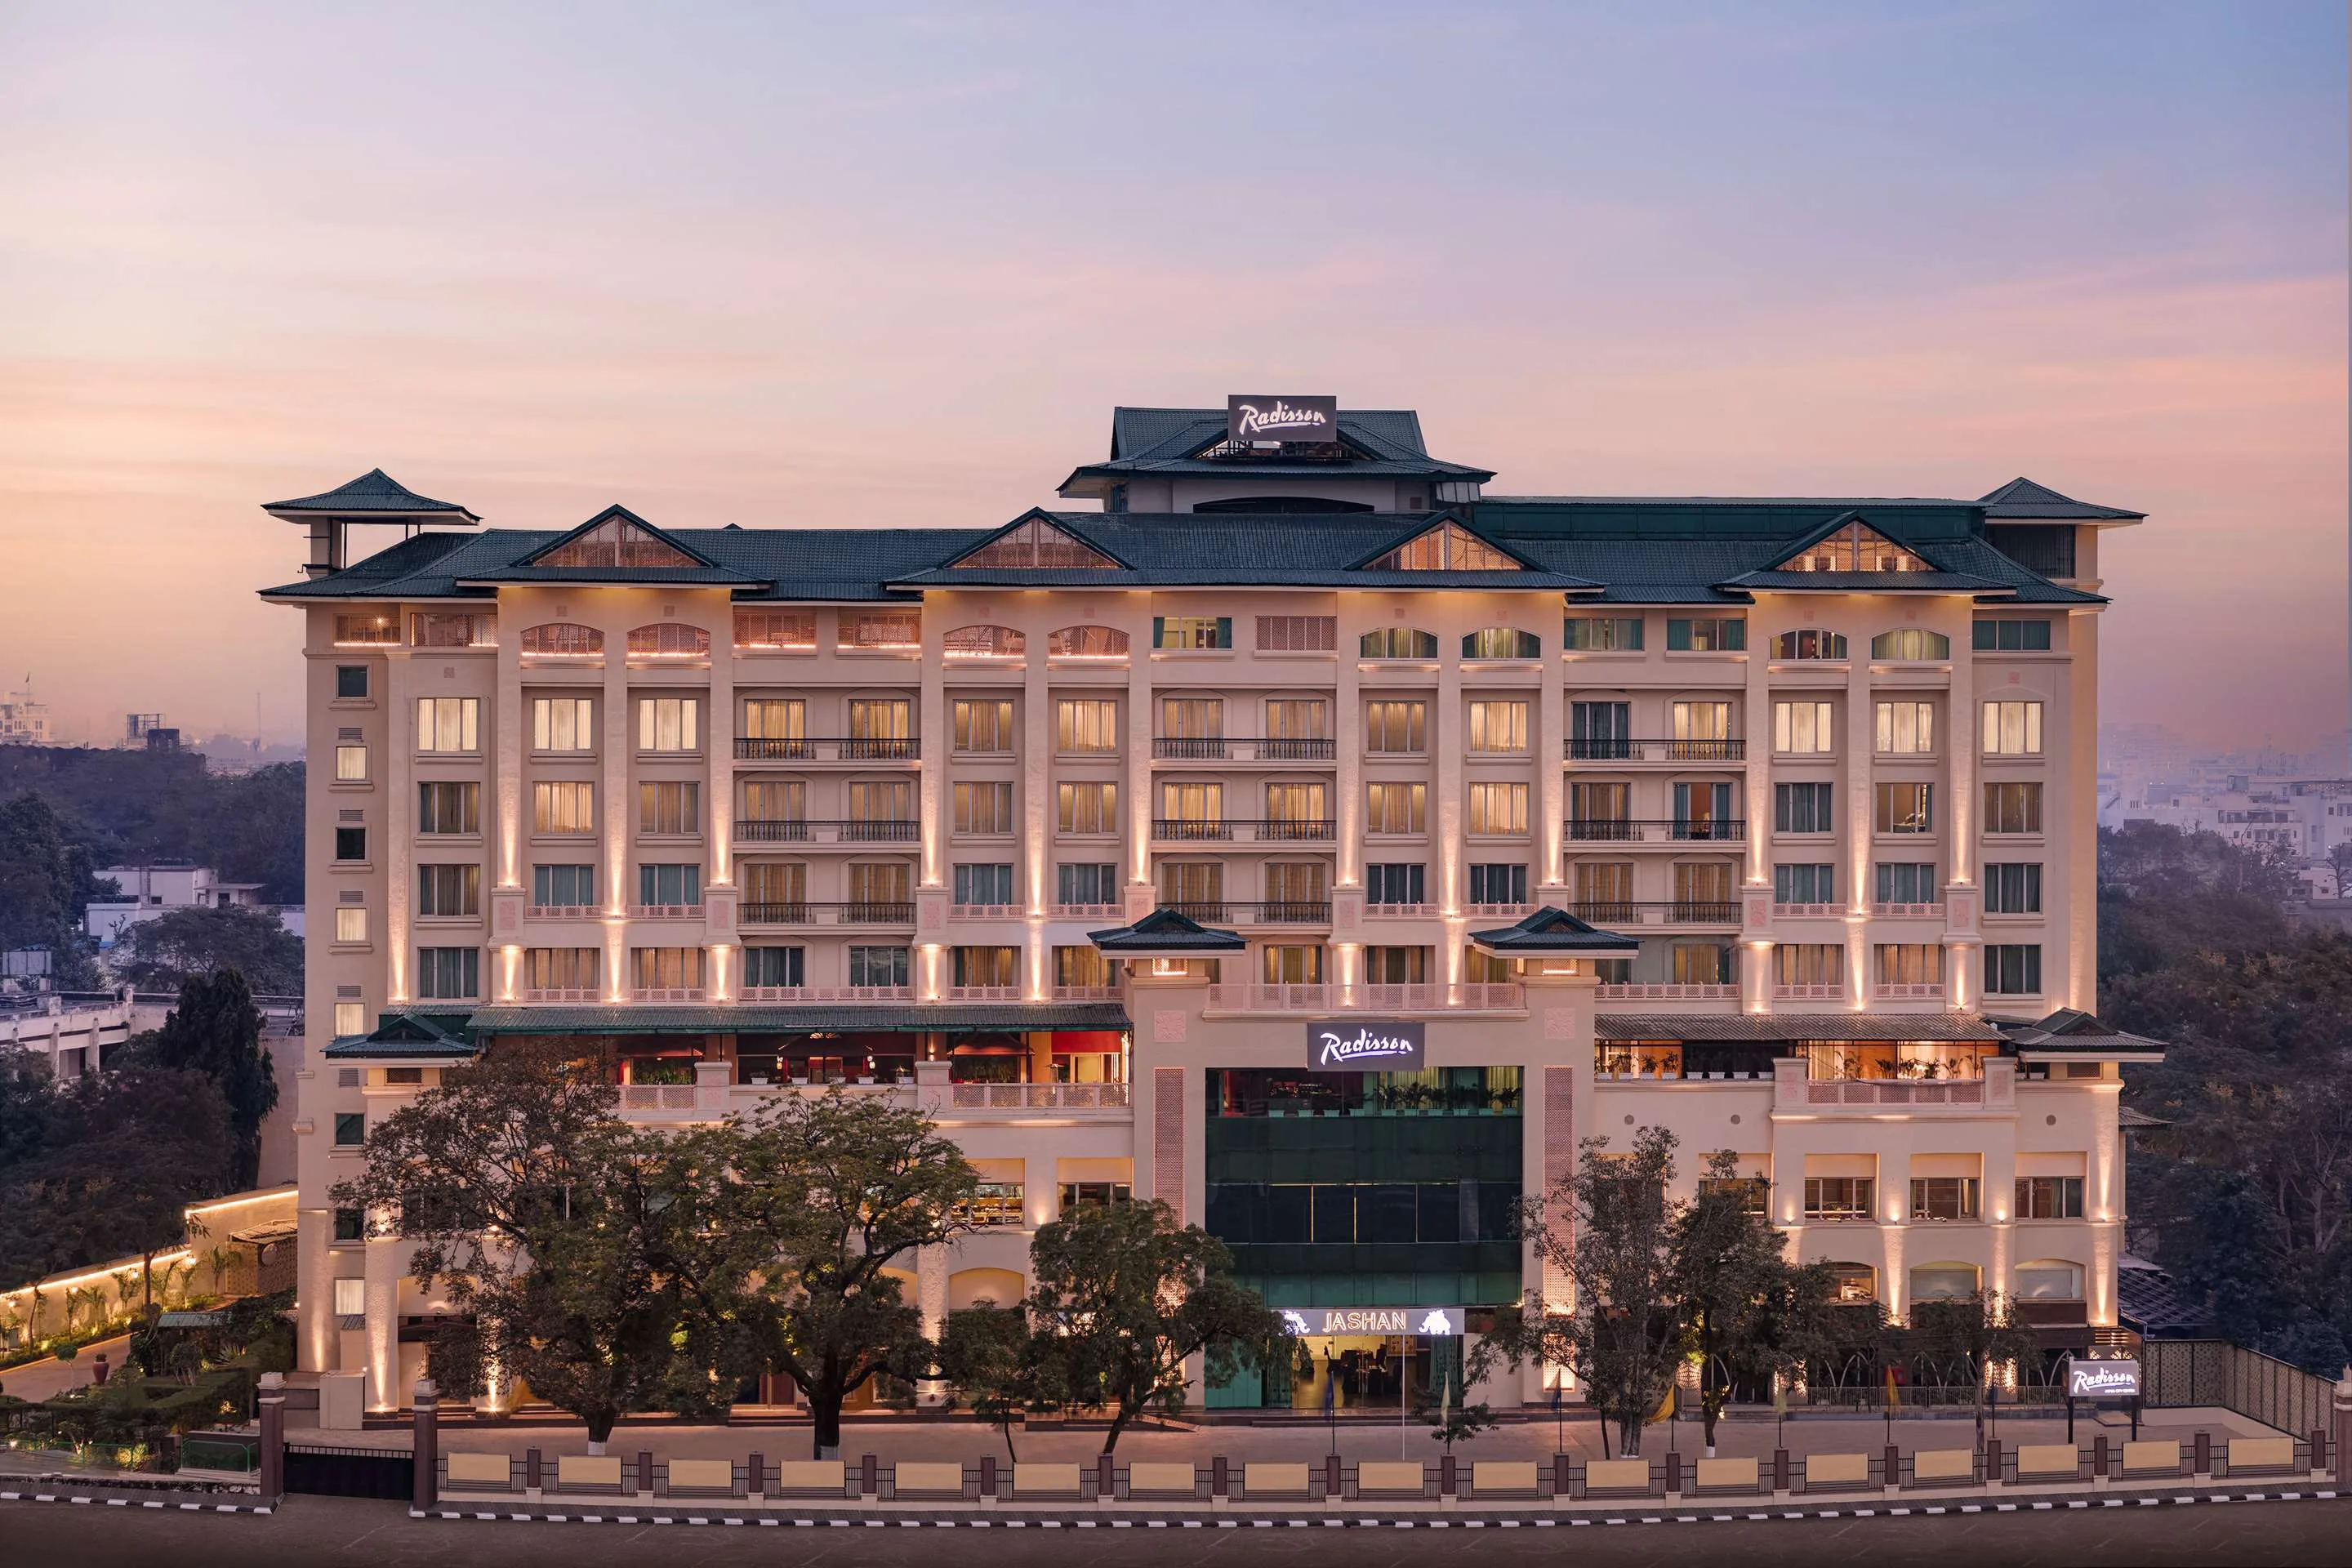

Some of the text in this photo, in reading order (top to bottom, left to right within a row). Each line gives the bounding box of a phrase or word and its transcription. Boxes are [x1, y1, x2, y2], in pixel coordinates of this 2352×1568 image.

[1239, 400, 1326, 434] Radisson
[1320, 1028, 1413, 1065] Radisson
[1322, 1312, 1406, 1332] JASHAN
[2074, 1367, 2136, 1393] Radisson
